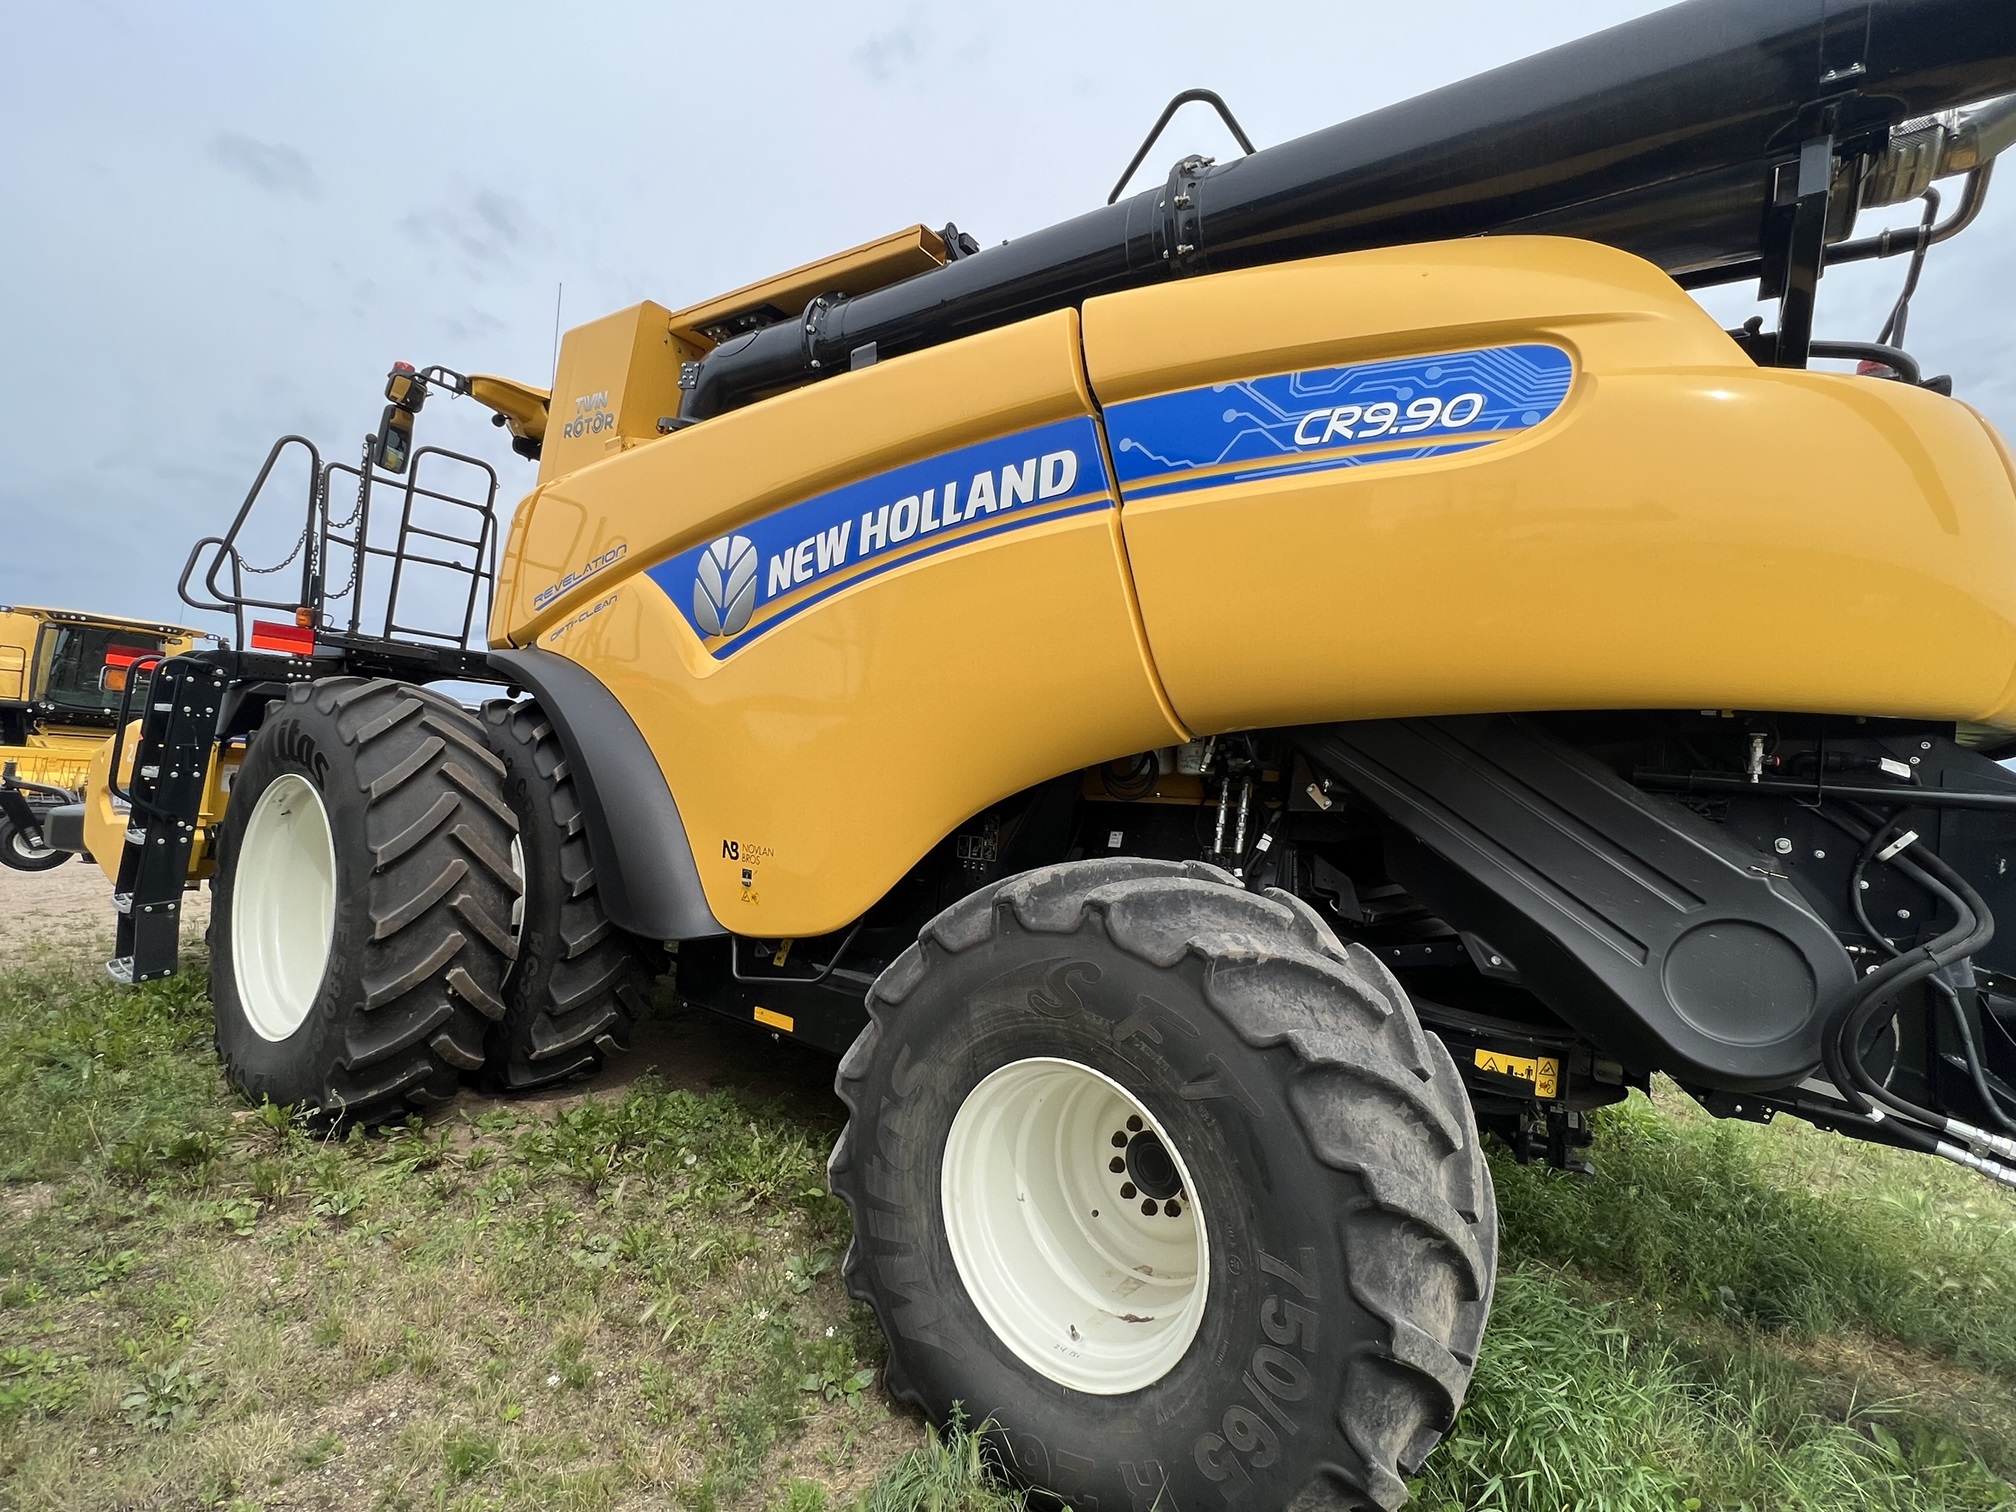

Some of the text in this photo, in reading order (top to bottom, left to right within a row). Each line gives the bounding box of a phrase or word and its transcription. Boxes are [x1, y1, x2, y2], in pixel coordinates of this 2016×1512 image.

[564, 410, 614, 439] ROTOR
[576, 390, 608, 414] TWIN
[1294, 393, 1484, 446] CR9.90
[768, 450, 1078, 598] NEW HOLLAND
[534, 544, 627, 607] REVELATION
[551, 595, 618, 641] OPTI-CLEAN
[741, 843, 774, 857] NOVLAN
[741, 853, 760, 865] BROS
[1027, 960, 1264, 1118] SFT
[1194, 1247, 1322, 1502] 750/65
